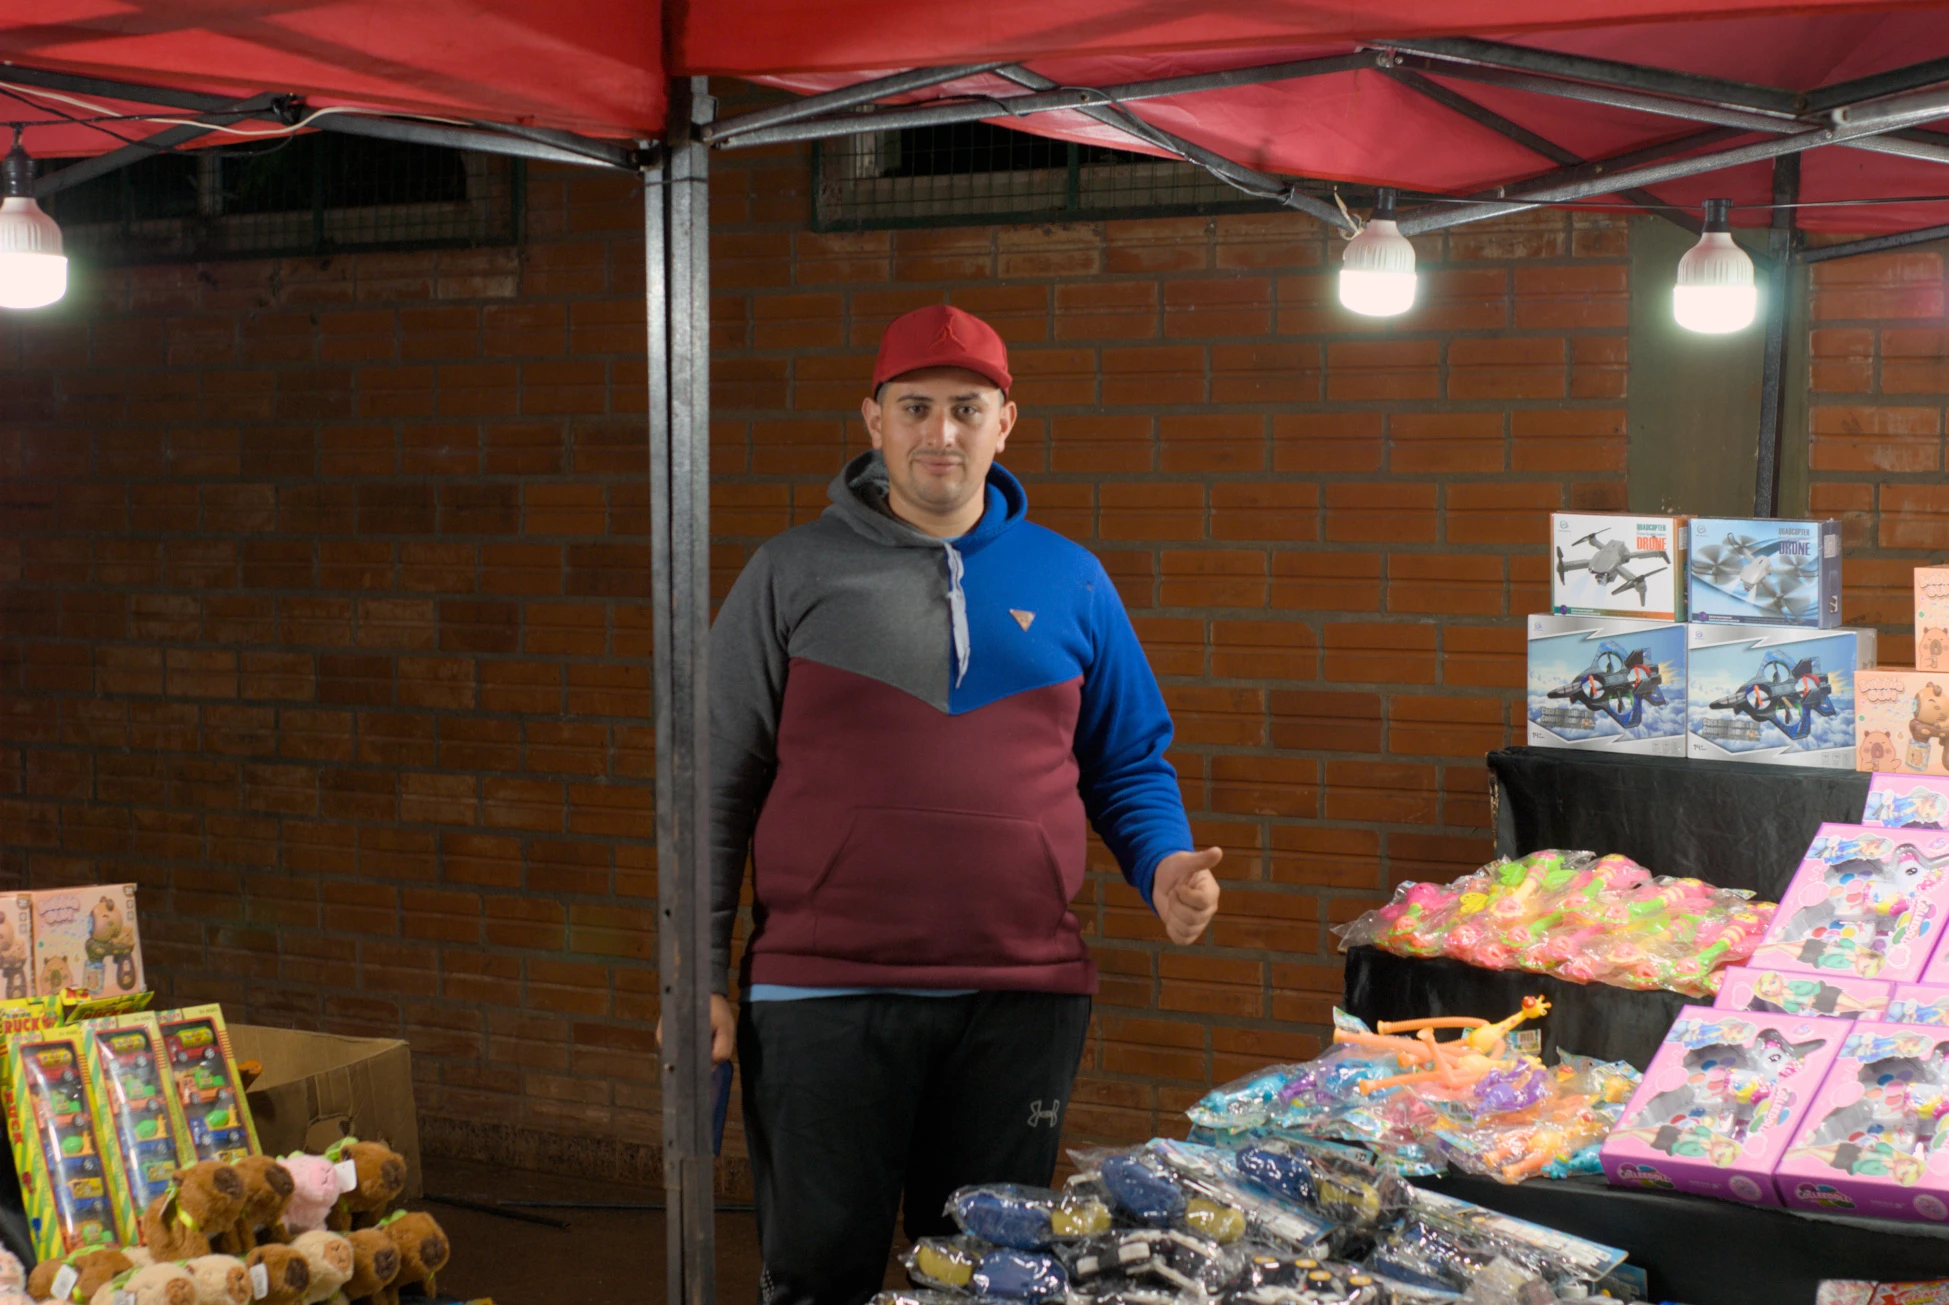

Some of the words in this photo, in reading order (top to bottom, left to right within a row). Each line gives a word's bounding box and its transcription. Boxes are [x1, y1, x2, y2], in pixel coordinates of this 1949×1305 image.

[1636, 536, 1667, 551] DRONE
[1778, 541, 1811, 556] DRONE
[0, 1017, 40, 1034] RUCK
